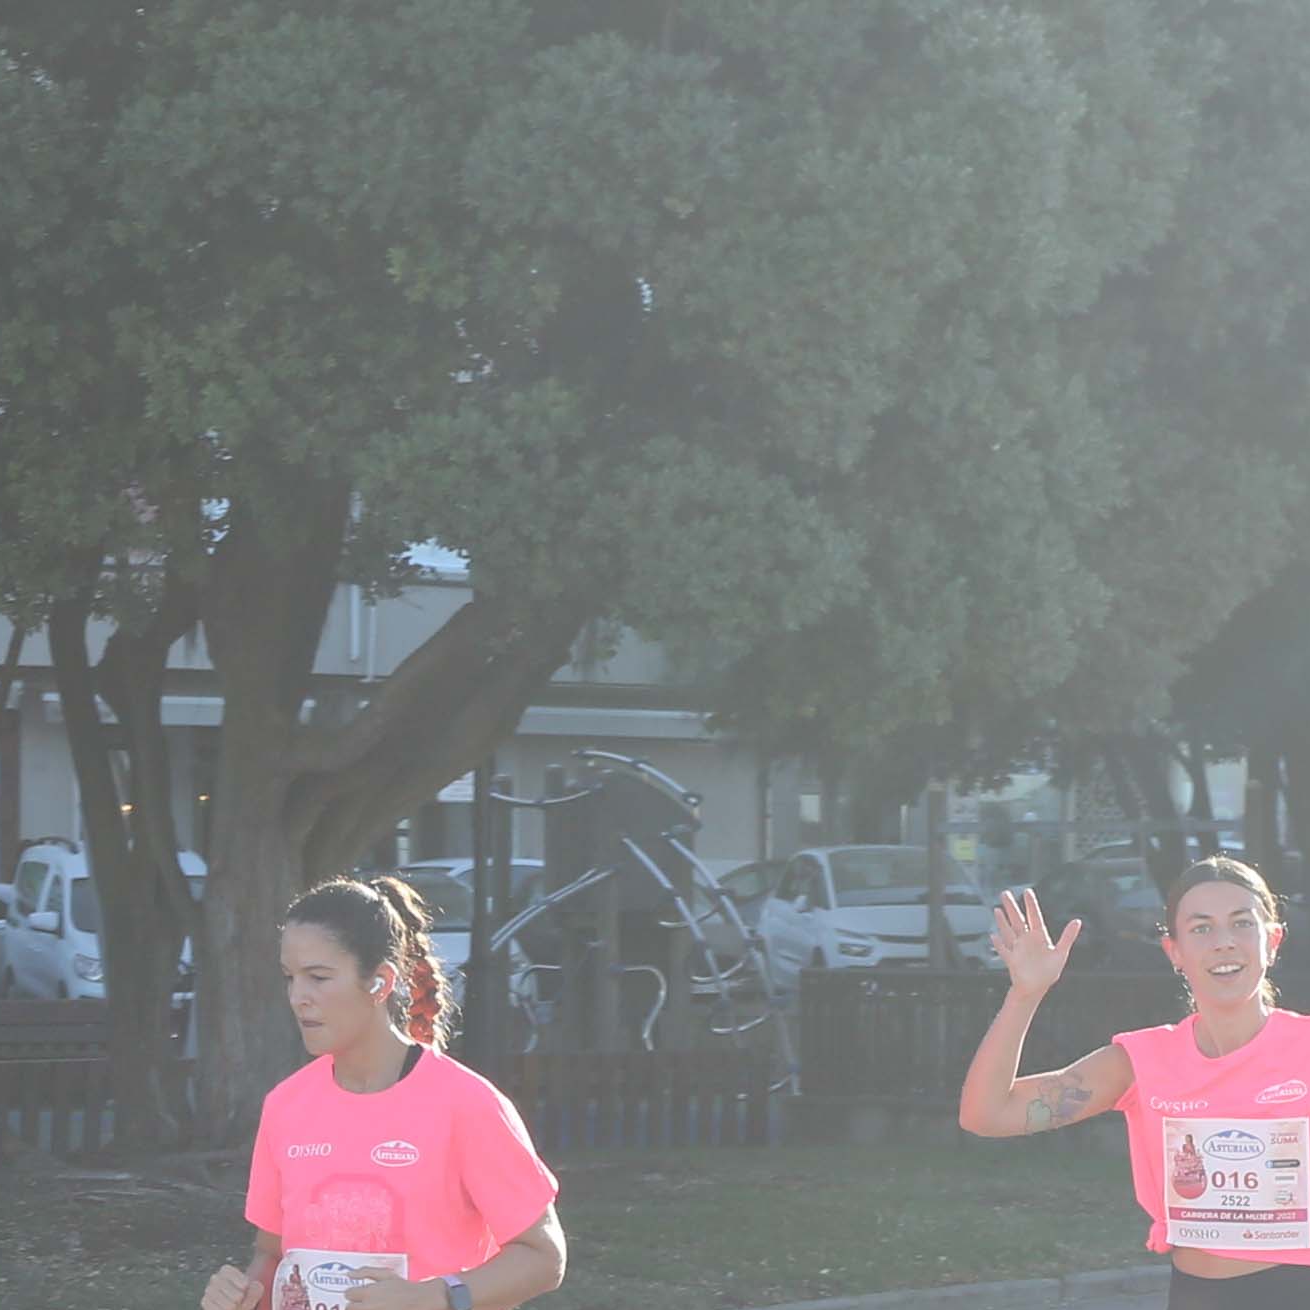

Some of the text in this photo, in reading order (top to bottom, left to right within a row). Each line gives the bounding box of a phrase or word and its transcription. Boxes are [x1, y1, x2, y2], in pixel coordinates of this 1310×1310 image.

[287, 1143, 332, 1158] OYSHO
[1211, 1170, 1259, 1189] 016
[1221, 1195, 1251, 1207] 2522
[1254, 1230, 1300, 1240] Santander
